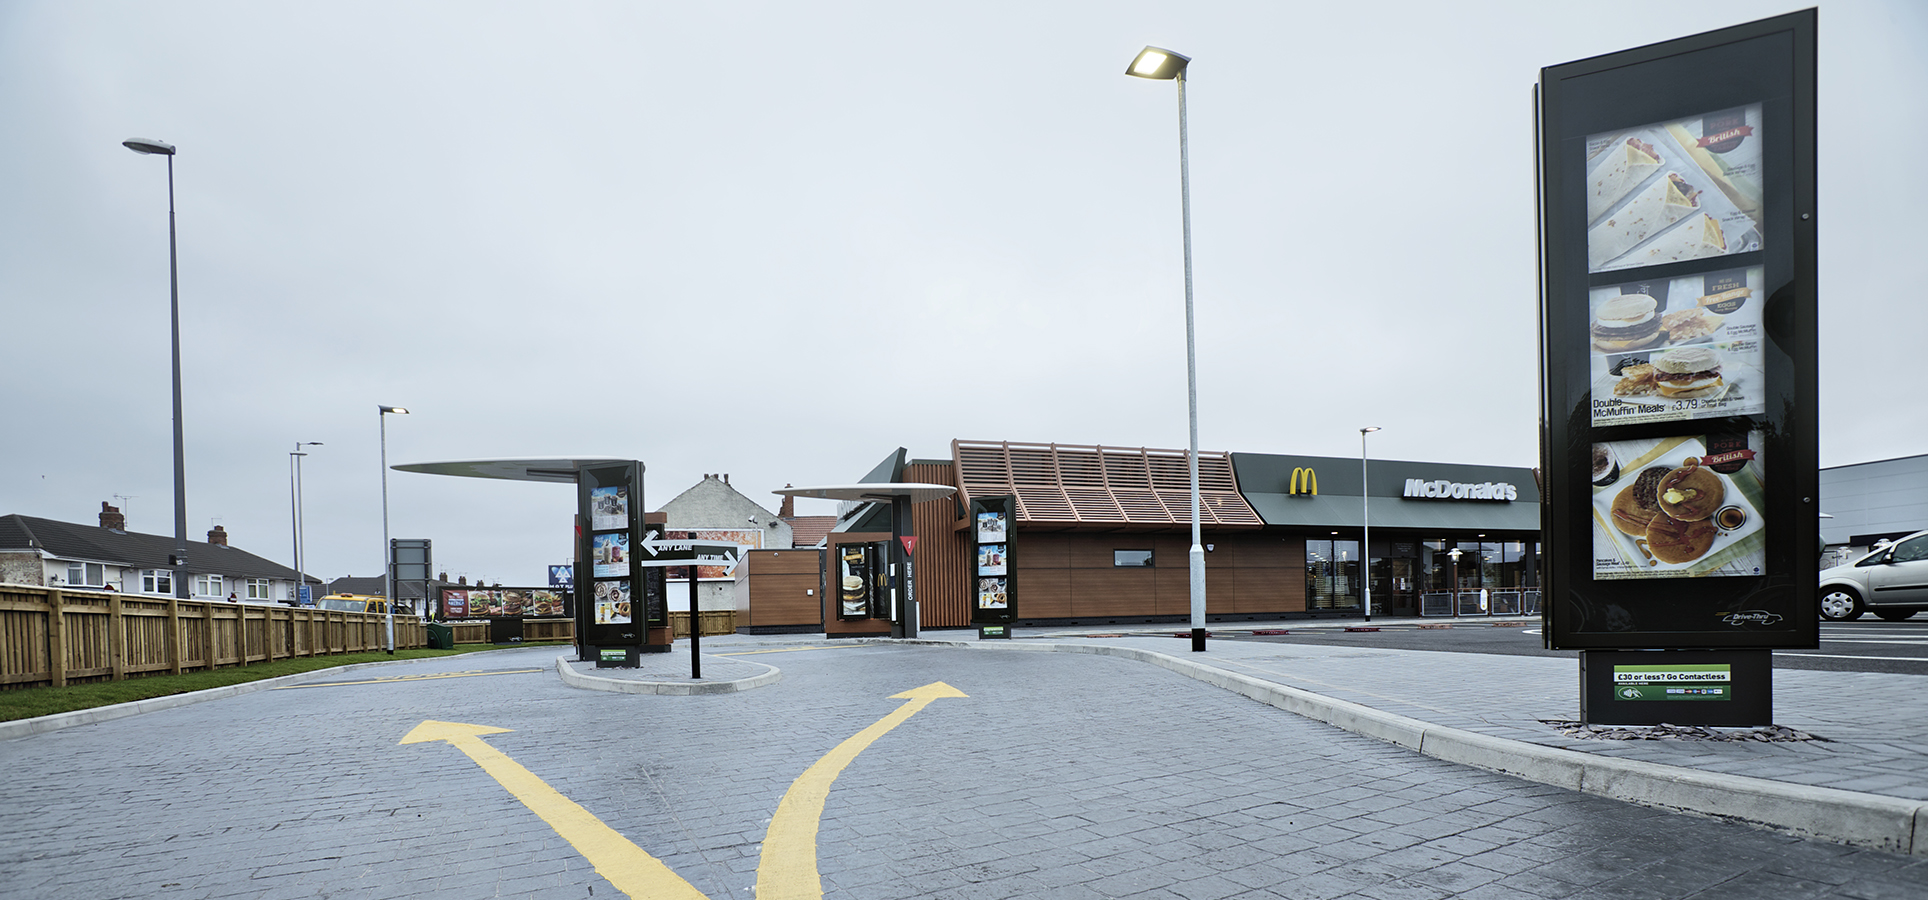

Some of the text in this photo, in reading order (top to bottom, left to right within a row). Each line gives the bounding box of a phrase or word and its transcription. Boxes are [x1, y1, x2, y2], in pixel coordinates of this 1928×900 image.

[1708, 129, 1740, 144] British
[1712, 282, 1739, 291] FRESH
[1593, 398, 1622, 408] Double
[1672, 399, 1698, 411] £3.79
[1712, 451, 1744, 463] British
[1404, 478, 1517, 501] McDonald's
[907, 540, 912, 549] 1
